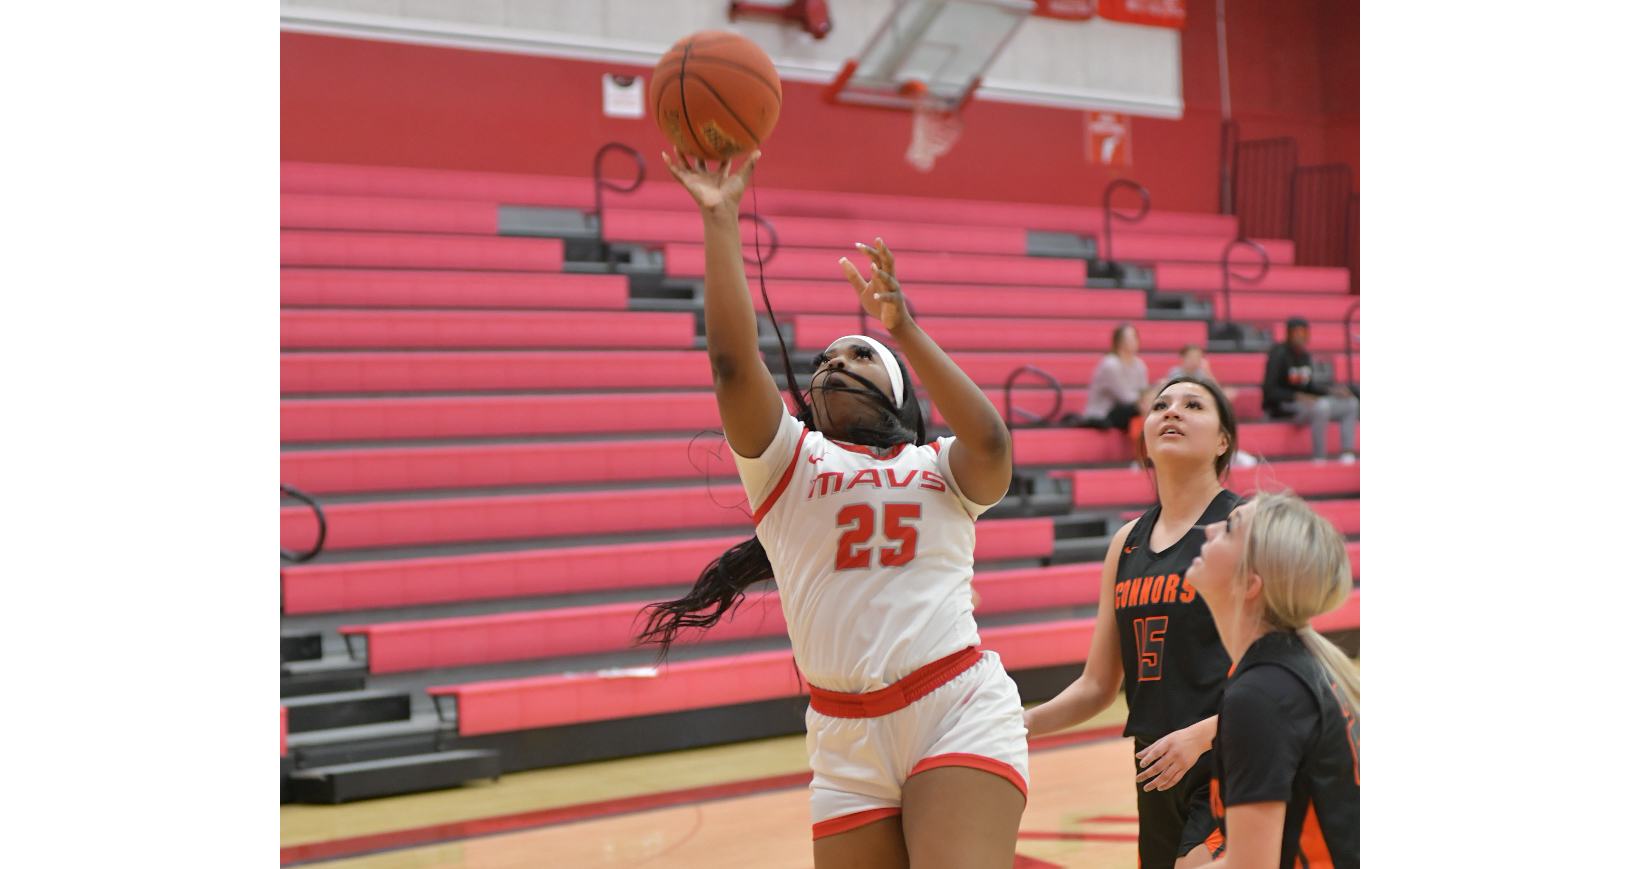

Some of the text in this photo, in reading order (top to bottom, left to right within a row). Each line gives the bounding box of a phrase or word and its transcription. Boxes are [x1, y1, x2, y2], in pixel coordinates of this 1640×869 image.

[808, 468, 946, 499] MAVS
[834, 502, 923, 571] 25
[1115, 573, 1196, 609] CONNORS
[1133, 615, 1168, 682] 15
